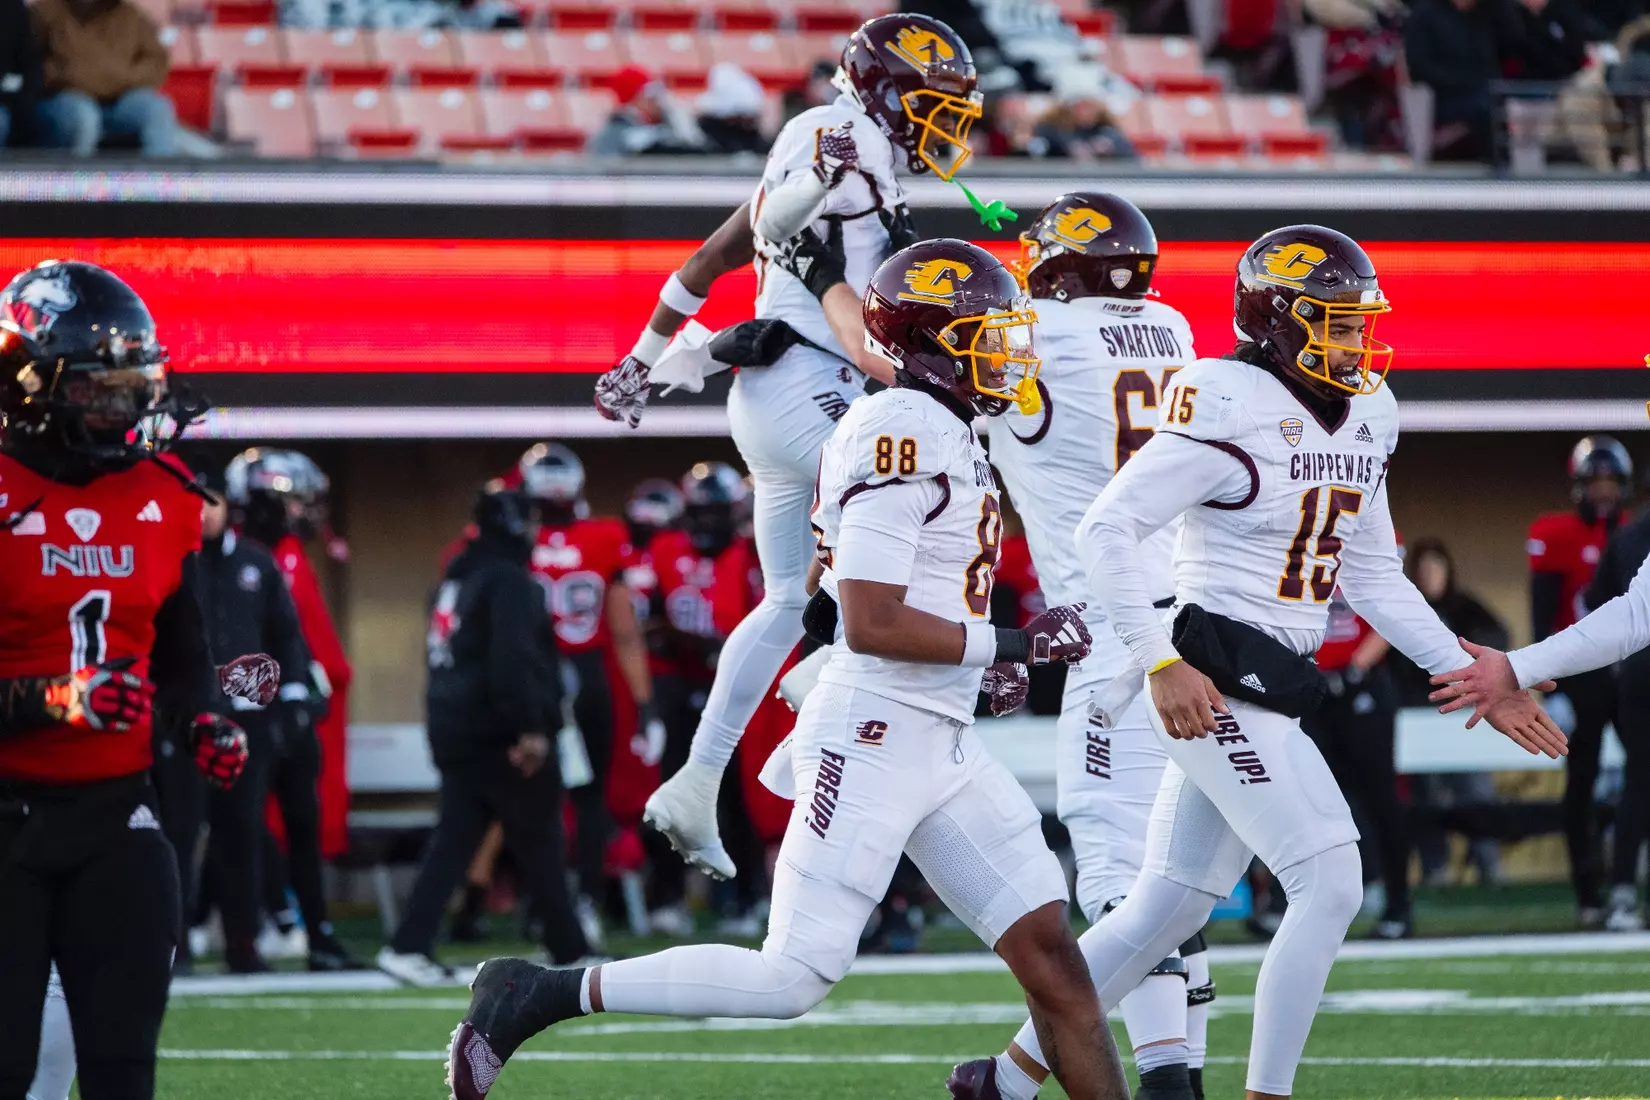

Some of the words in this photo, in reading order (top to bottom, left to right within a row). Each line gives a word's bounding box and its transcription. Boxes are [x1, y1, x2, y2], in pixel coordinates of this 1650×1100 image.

[1099, 324, 1183, 359] SWARTOUT
[1112, 367, 1185, 475] 6
[1166, 385, 1198, 425] 15
[875, 434, 917, 476] 88
[1355, 433, 1374, 443] adidas
[1290, 453, 1373, 484] CHIPPEWAS
[40, 543, 135, 578] NIU
[1277, 485, 1363, 604] 15
[69, 589, 112, 682] 1
[1239, 676, 1267, 694] adidas
[1085, 731, 1112, 780] FIRE
[1227, 750, 1272, 785] UP!
